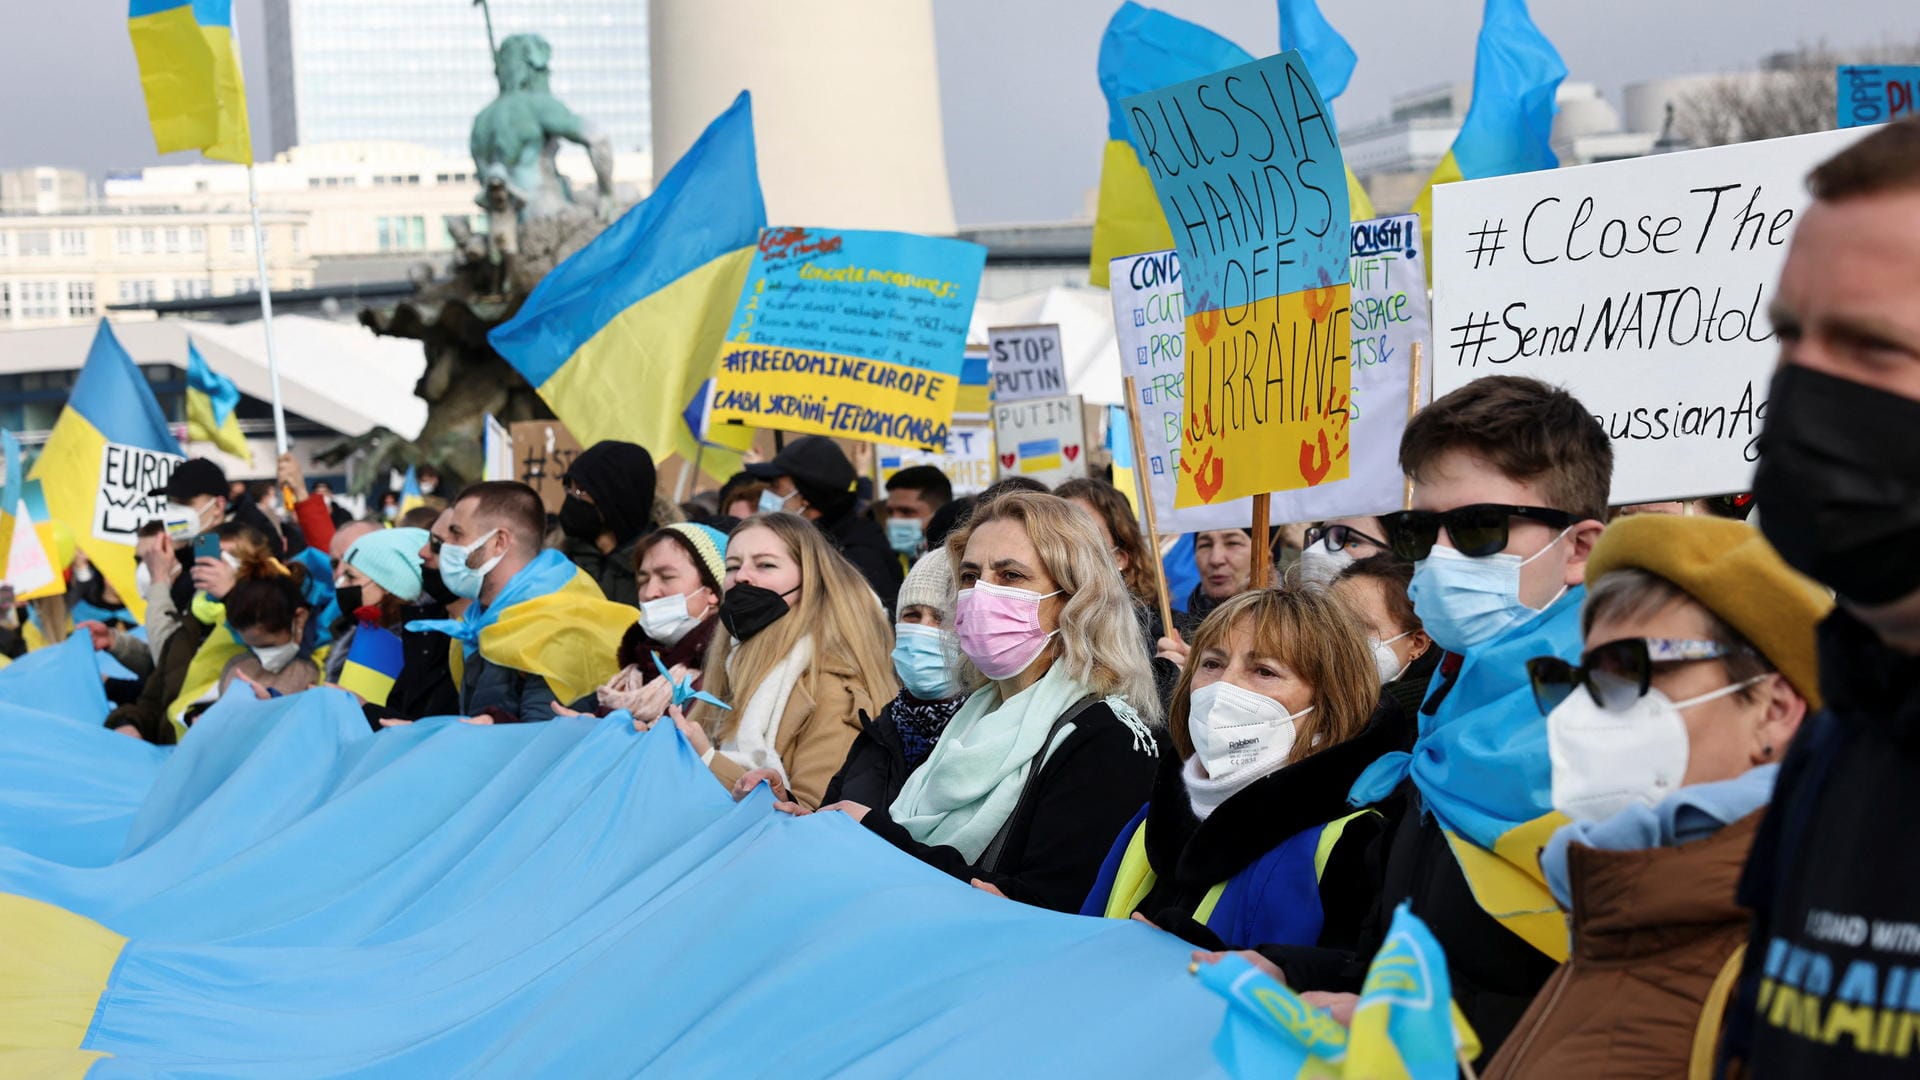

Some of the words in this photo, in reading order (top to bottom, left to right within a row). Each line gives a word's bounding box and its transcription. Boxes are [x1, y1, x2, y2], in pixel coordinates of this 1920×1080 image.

[1132, 62, 1335, 179] RUSSIA
[1170, 158, 1332, 258] HANDS
[1130, 252, 1182, 290] COND
[1223, 239, 1295, 326] OFF
[993, 337, 1056, 363] STOP
[1150, 331, 1185, 367] PRO
[722, 350, 944, 401] #FREEDOMINEUROPE
[995, 367, 1061, 393] PUTIN
[1190, 308, 1349, 442] UKRAINE
[998, 400, 1072, 429] PUTIN
[1228, 737, 1260, 750] Rabben
